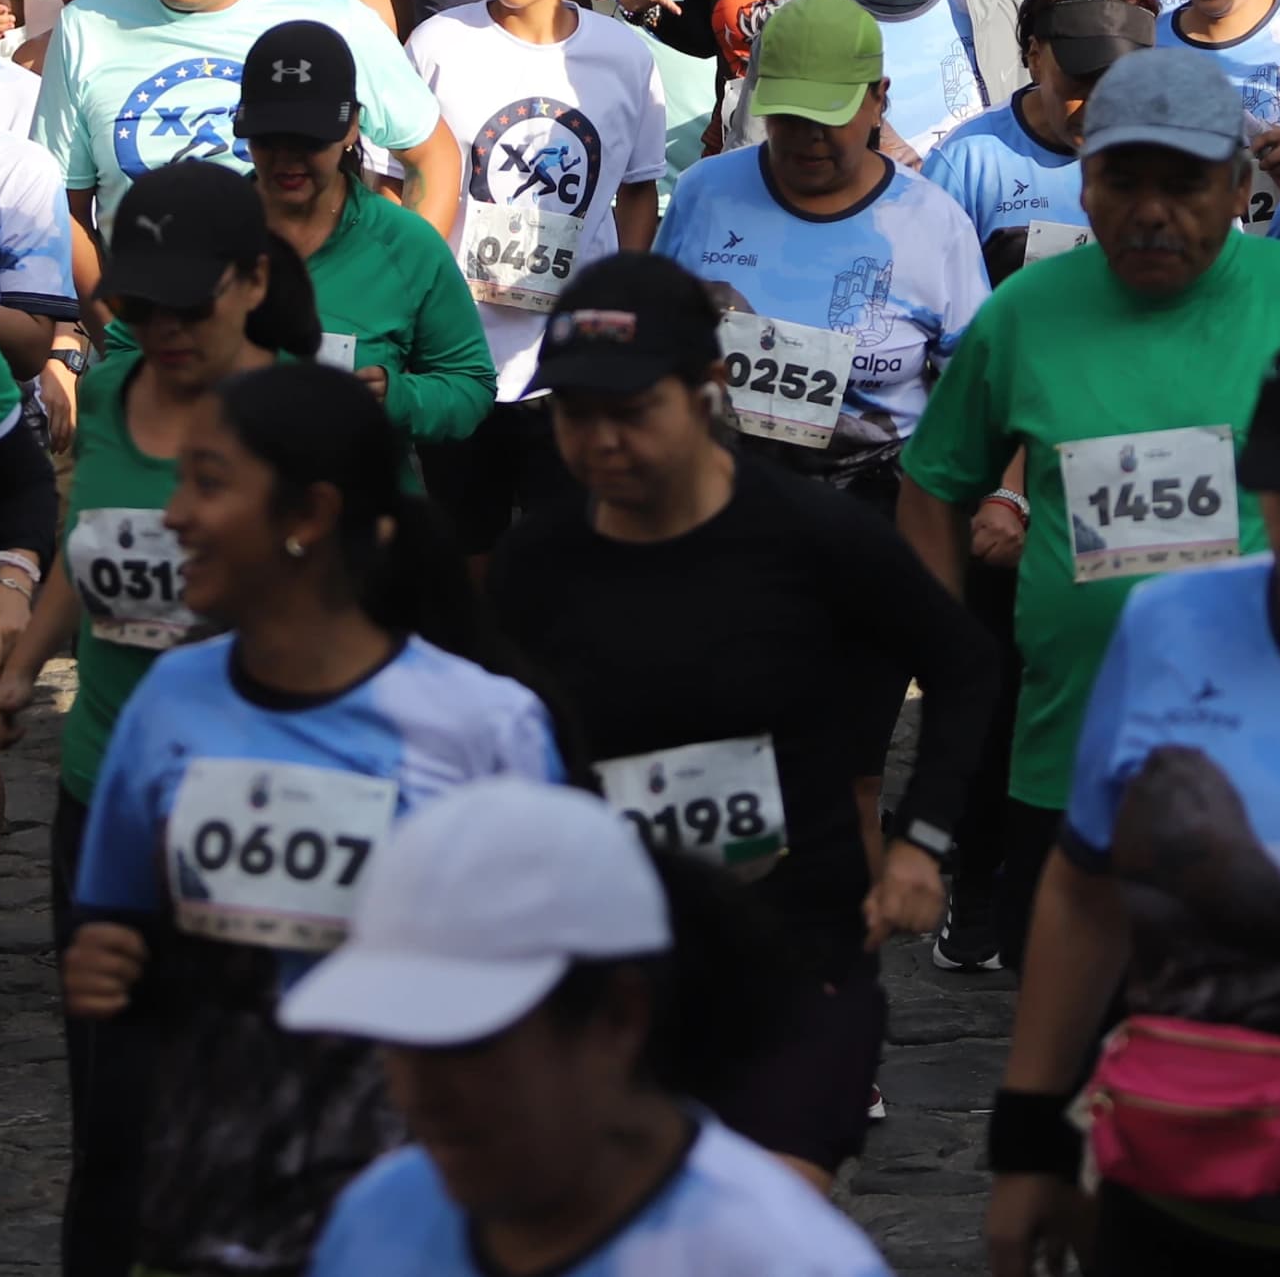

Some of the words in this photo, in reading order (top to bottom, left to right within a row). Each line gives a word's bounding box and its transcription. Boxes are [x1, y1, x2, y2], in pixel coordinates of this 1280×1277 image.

[498, 143, 532, 173] X
[558, 173, 581, 205] C
[996, 195, 1049, 214] sporelli
[477, 236, 574, 280] 0465
[701, 250, 759, 267] sporelli
[724, 352, 838, 407] 0252
[851, 353, 902, 375] alpa
[1088, 475, 1222, 527] 1456
[194, 819, 373, 888] 0607
